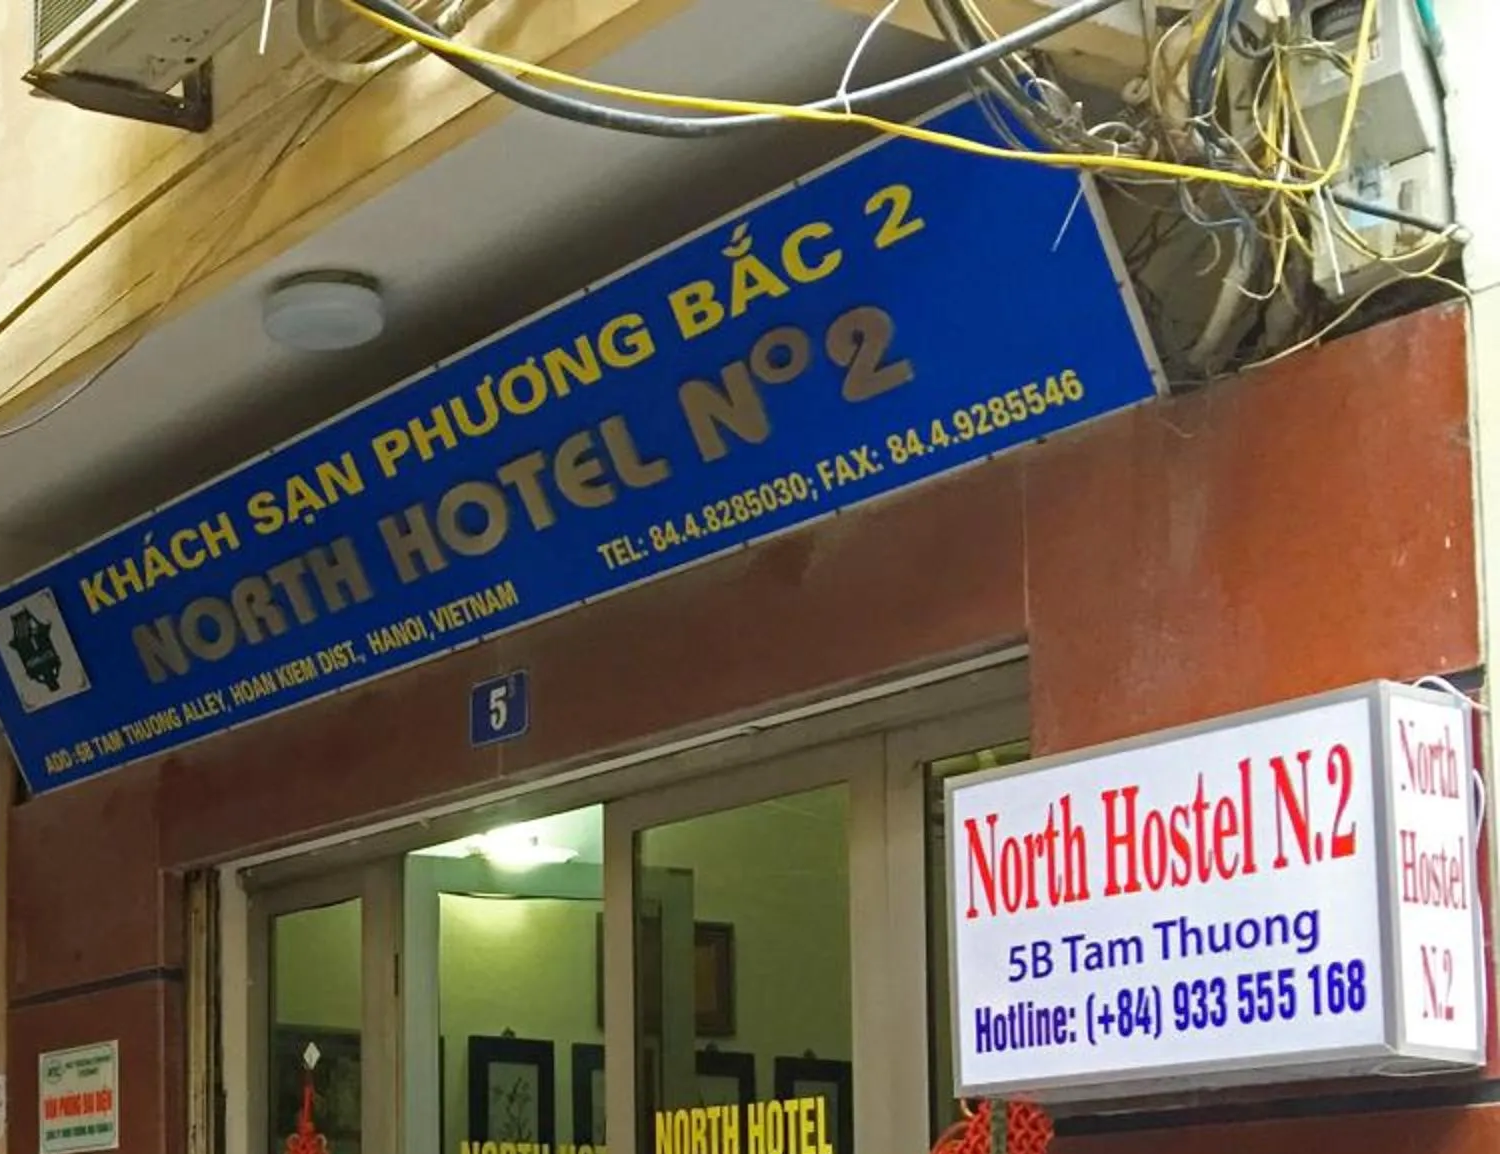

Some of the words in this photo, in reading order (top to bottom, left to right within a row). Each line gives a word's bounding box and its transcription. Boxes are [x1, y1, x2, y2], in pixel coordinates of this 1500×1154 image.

[79, 525, 241, 614] KHÁCH
[247, 452, 366, 537] SẠN
[372, 312, 656, 479] PHƯƠNG
[667, 220, 843, 340] BẮC
[863, 183, 926, 250] 2
[597, 536, 649, 571] TEL:
[816, 443, 885, 492] FAX:
[885, 368, 1086, 467] 84.4.9285546
[131, 540, 376, 684] NORTH
[379, 414, 672, 586] HOTEL
[93, 728, 126, 756] TAM
[121, 706, 184, 746] THUONG
[229, 671, 277, 707] HOAN
[276, 657, 318, 690] KIEM
[429, 579, 520, 635] VIETNAM
[1398, 718, 1461, 801] North
[964, 793, 1091, 920] North
[1100, 758, 1258, 898] Hostel
[1269, 743, 1357, 871] N.2
[1400, 829, 1469, 911] Hostel
[975, 1004, 1077, 1054] Hotline:
[1085, 985, 1162, 1046] (+84)
[1173, 976, 1227, 1031] 933
[1237, 967, 1297, 1025] 555
[1306, 959, 1367, 1017] 168
[1008, 940, 1054, 983] 5B
[1062, 933, 1144, 975] Tam
[1152, 909, 1320, 961] Thuong
[1421, 944, 1456, 1022] N.2
